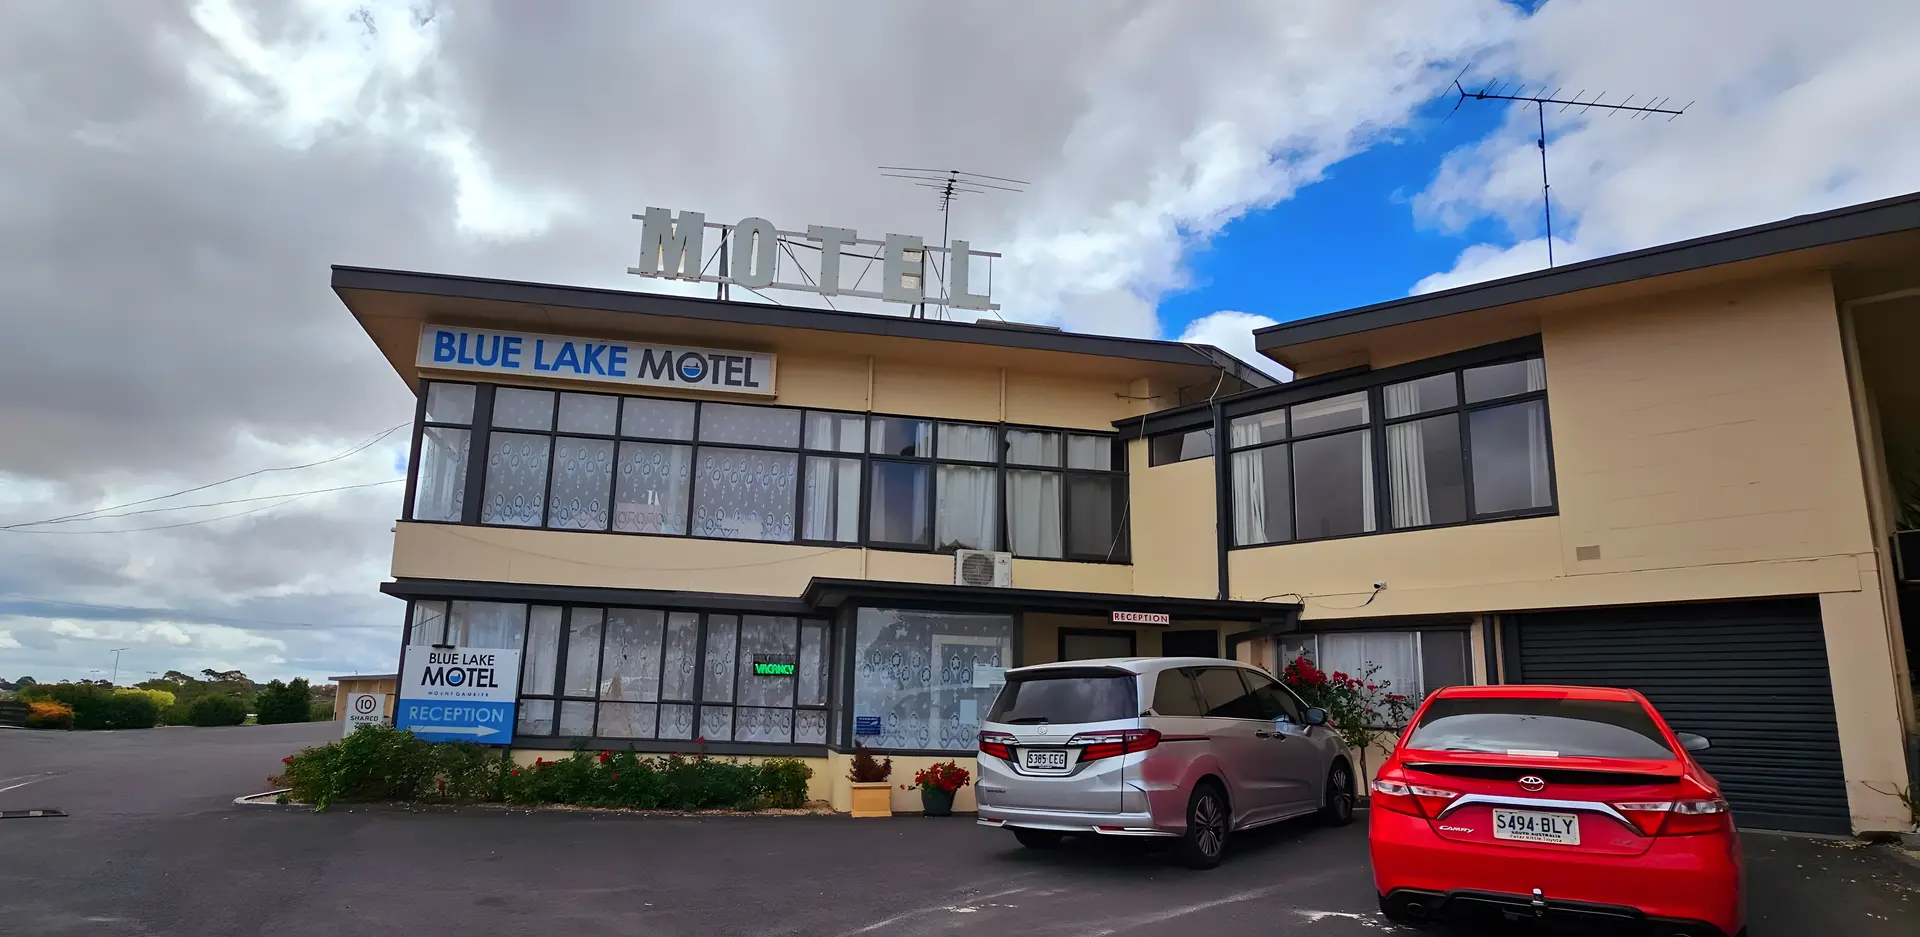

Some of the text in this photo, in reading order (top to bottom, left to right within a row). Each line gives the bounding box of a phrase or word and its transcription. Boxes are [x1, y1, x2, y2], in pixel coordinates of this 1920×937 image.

[638, 206, 991, 310] MOTEL
[433, 331, 759, 388] BLUE LAKE MOTEL
[1114, 613, 1168, 622] RECEPTION
[429, 652, 495, 666] BLUE LAKE
[421, 666, 498, 688] MOTEL
[755, 664, 794, 675] VACANCY
[360, 699, 372, 710] 10
[409, 705, 504, 723] RECEPTION
